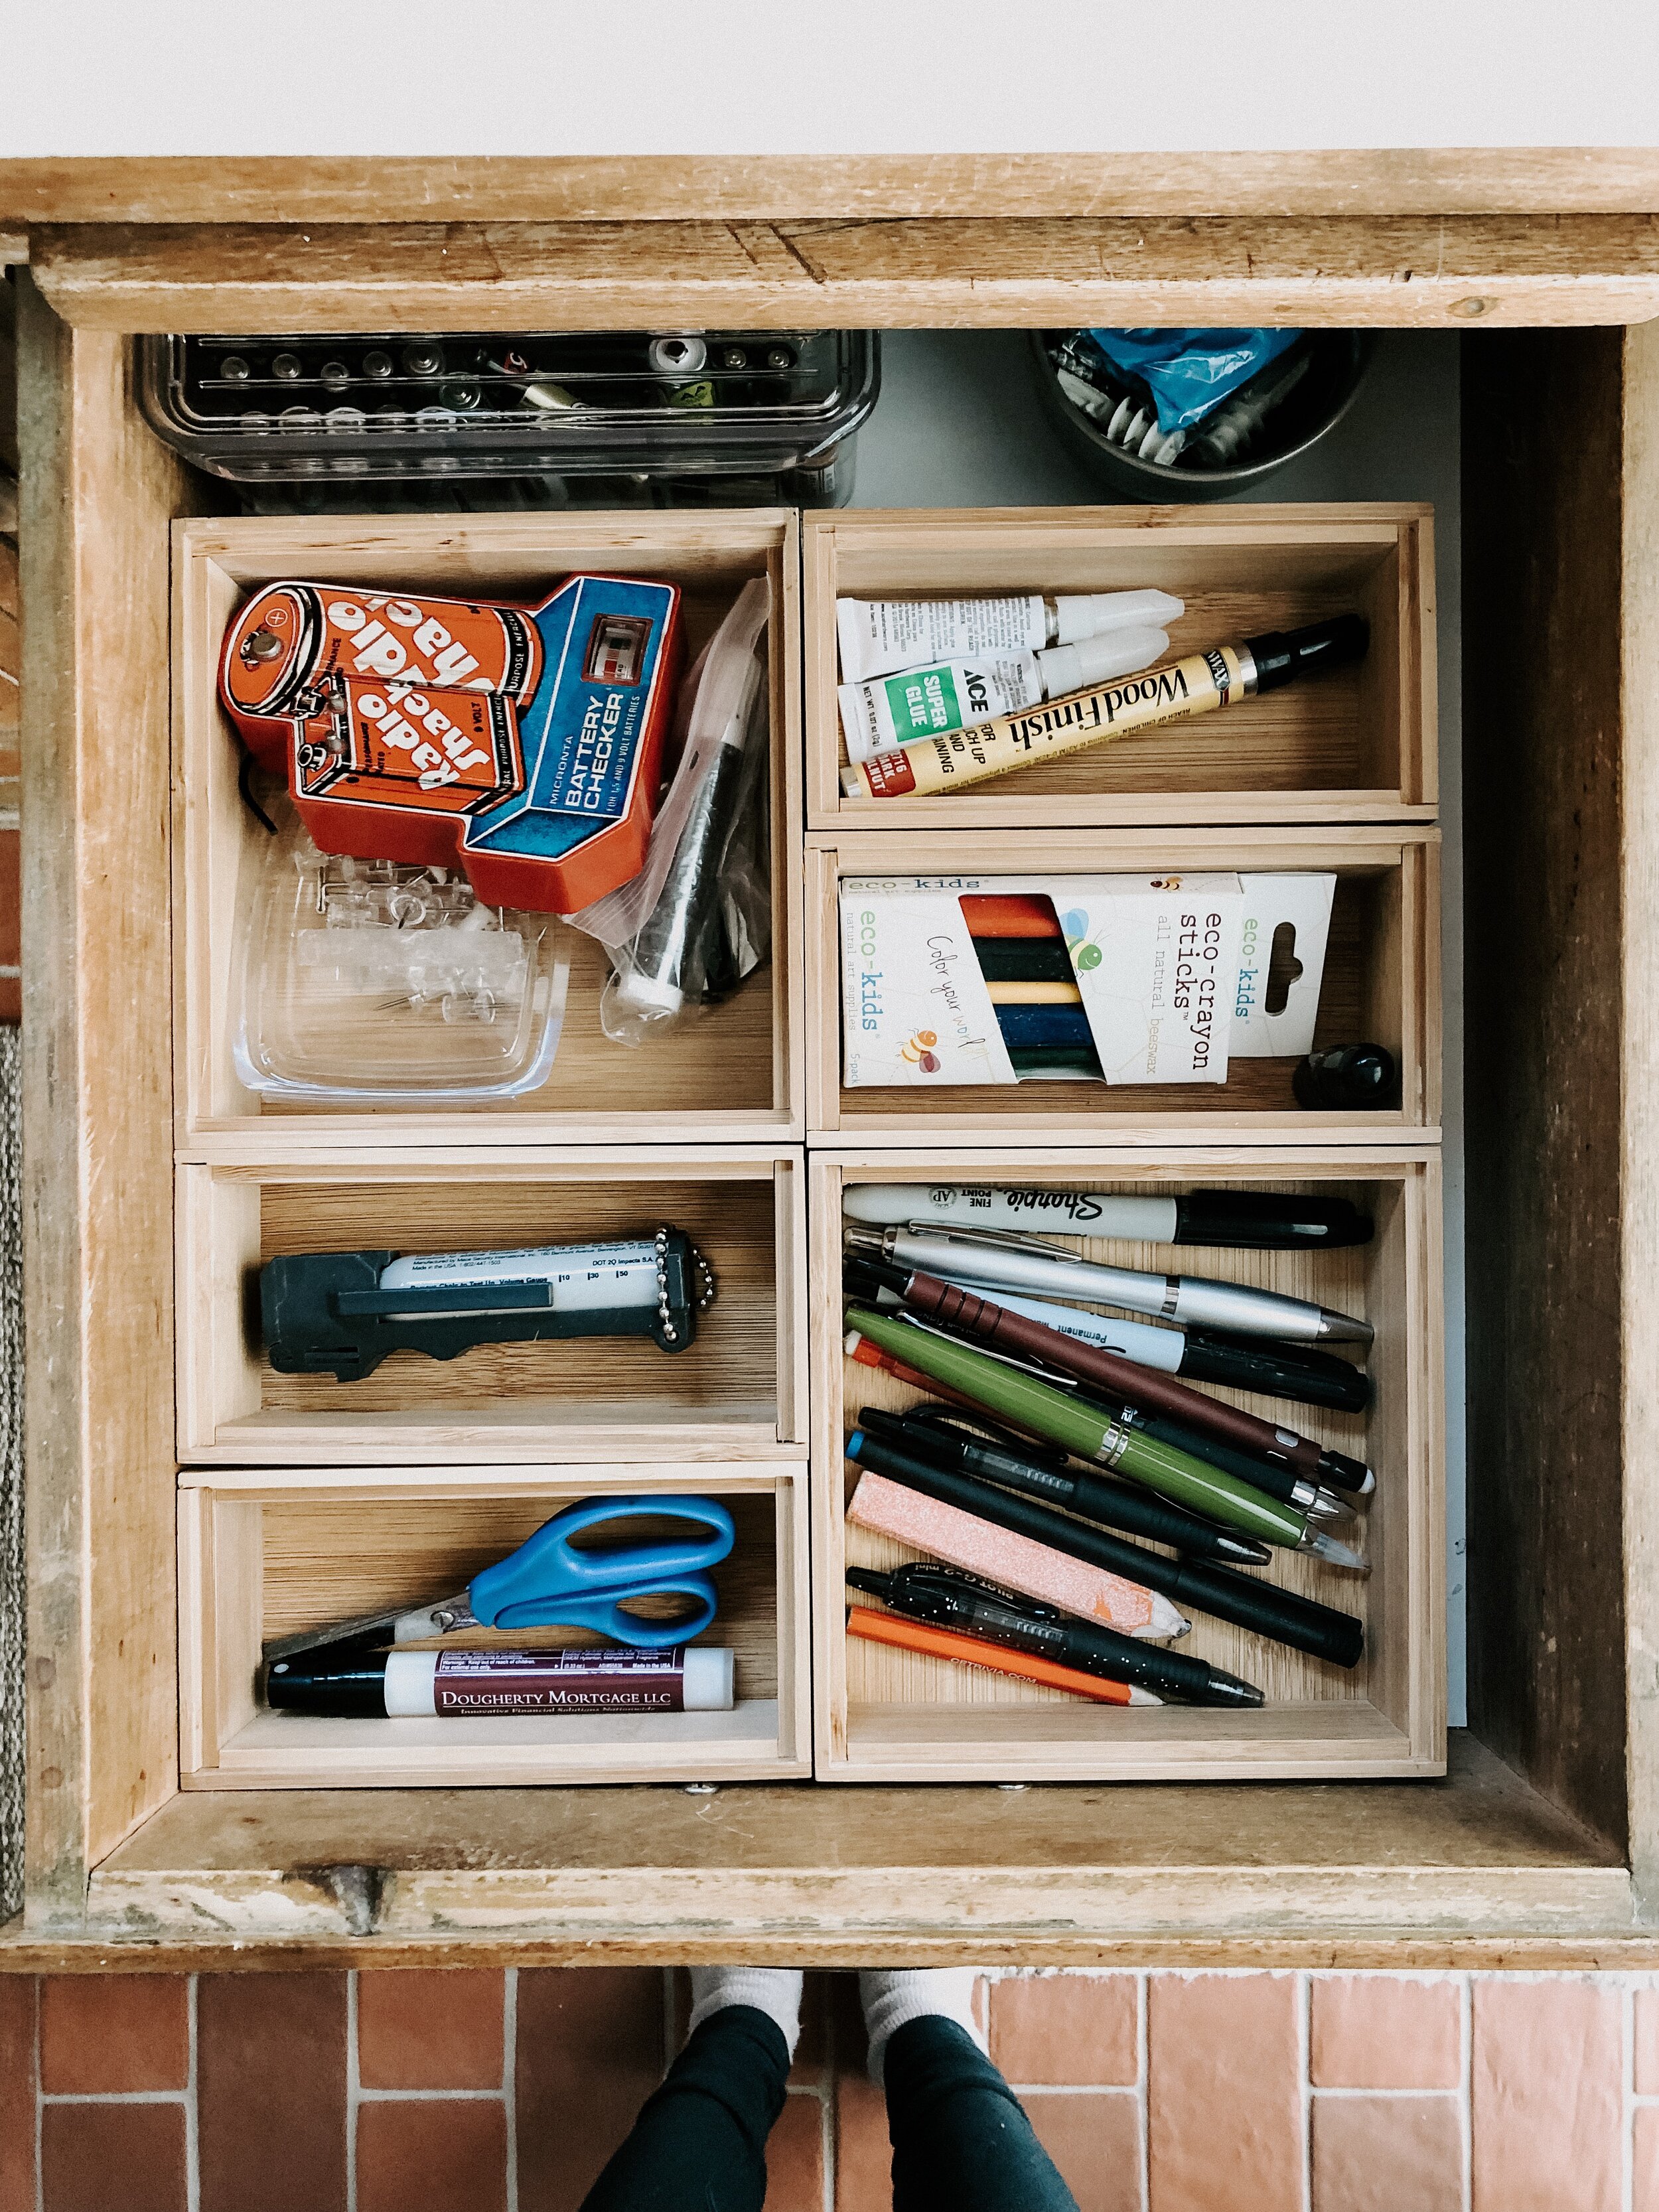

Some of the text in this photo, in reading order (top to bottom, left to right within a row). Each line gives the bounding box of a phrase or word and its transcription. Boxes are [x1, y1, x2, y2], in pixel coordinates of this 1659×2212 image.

[867, 700, 874, 709] WT
[923, 675, 948, 728] SUPER
[964, 670, 988, 711] ACE
[471, 702, 482, 723] VOLT
[623, 696, 640, 735] BATTERIES
[904, 686, 927, 727] GLUE
[384, 680, 491, 771] Shack
[979, 723, 996, 741] FOR
[356, 693, 461, 792] Radio
[565, 696, 605, 807] BATTERY
[584, 692, 624, 810] CHECKER
[618, 737, 630, 755] VOLT
[948, 733, 965, 752] AND
[970, 747, 987, 765] UP
[549, 735, 573, 804] MICRONTA
[613, 765, 624, 780] AND
[606, 796, 617, 811] FOR
[849, 879, 979, 889] eco-kids
[861, 911, 883, 1030] eco-kids
[927, 936, 958, 975] Color
[1236, 919, 1258, 1017] eco-kids
[931, 981, 961, 1011] your
[1147, 916, 1171, 1074] all natural beeswax
[1190, 913, 1221, 1070] eco-crayon
[846, 985, 856, 1030] supplies
[849, 1053, 860, 1084] 5-pack
[933, 1191, 951, 1201] AP
[970, 1198, 991, 1207] FINE
[1003, 1190, 1111, 1220] Sharpie
[1057, 1325, 1107, 1343] Permanent
[944, 1568, 976, 1583] G-2
[979, 1580, 1013, 1599] PILOT
[441, 1691, 671, 1706] DOUGHERTY MORTGAGE LLC
